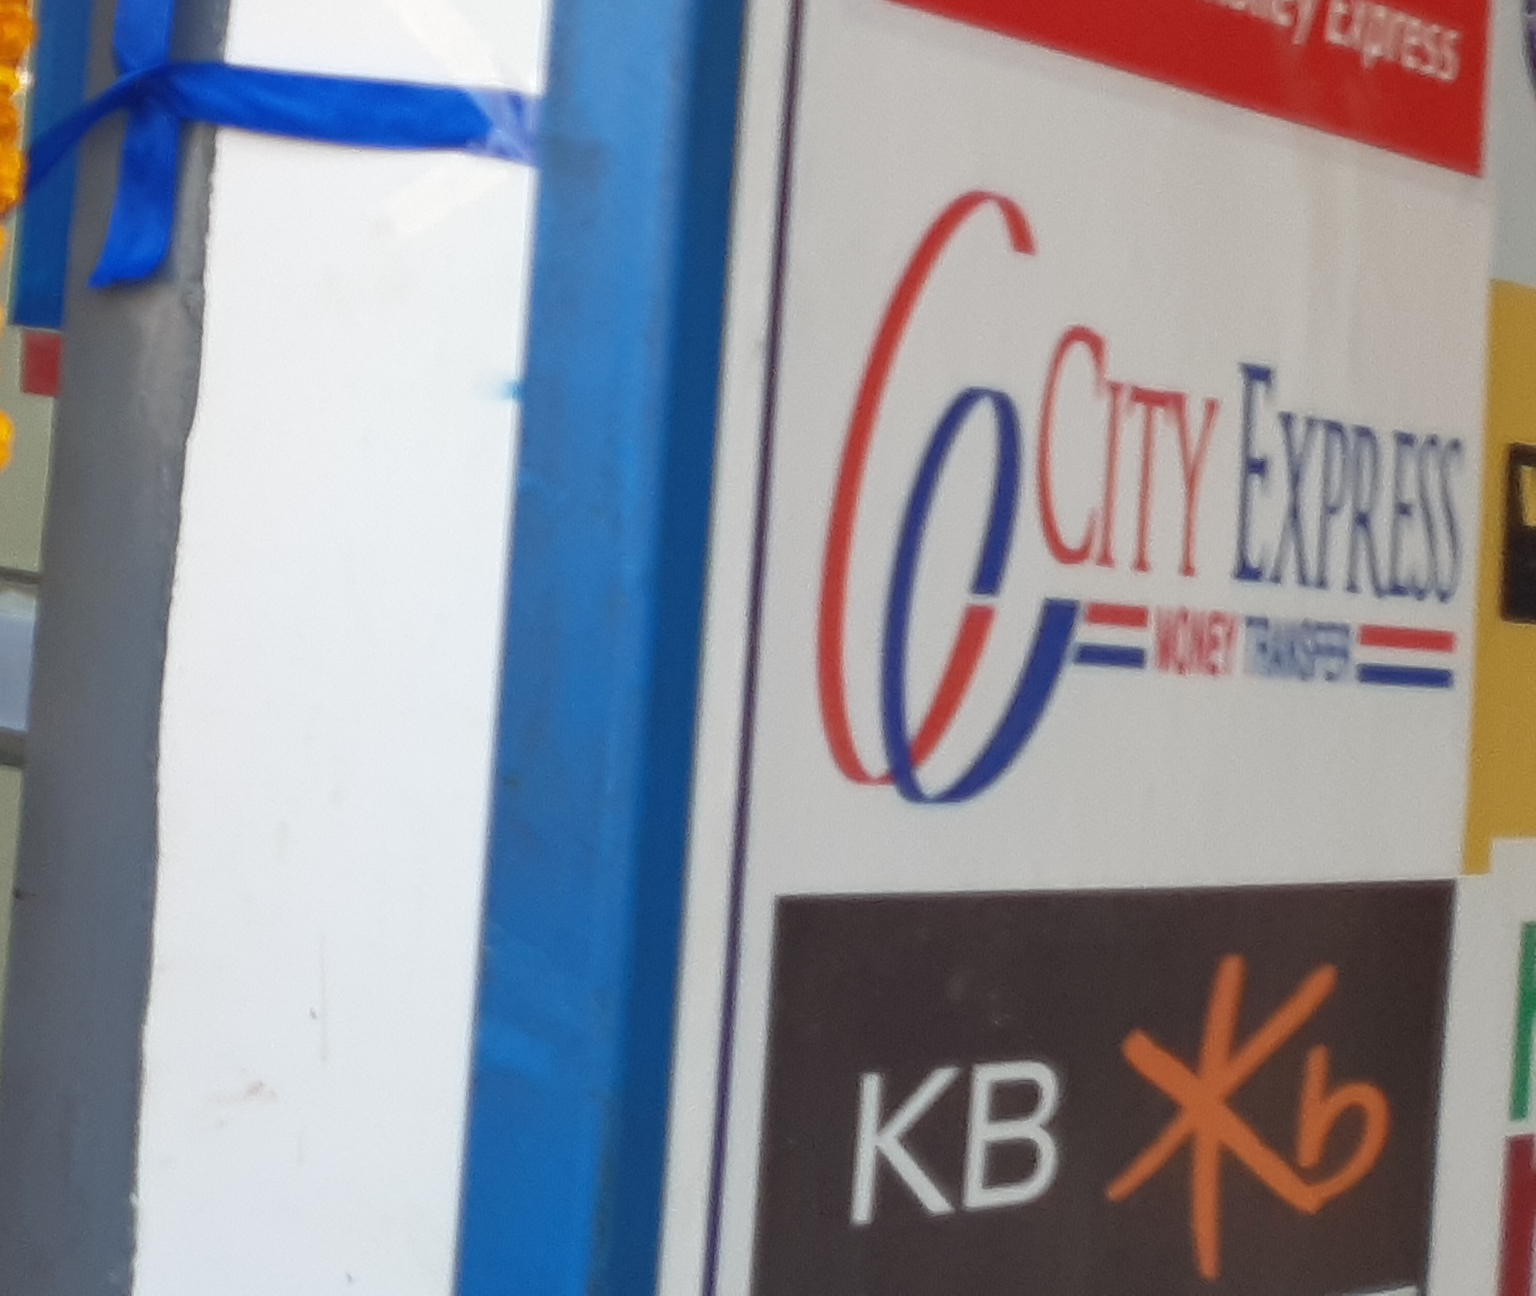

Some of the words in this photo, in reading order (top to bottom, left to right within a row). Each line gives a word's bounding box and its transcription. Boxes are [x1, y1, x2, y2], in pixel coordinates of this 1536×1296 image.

[1037, 324, 1219, 578] CITY
[1232, 361, 1466, 603] EXPRESS
[1154, 604, 1240, 678] MONEY
[849, 1058, 1062, 1228] KB
